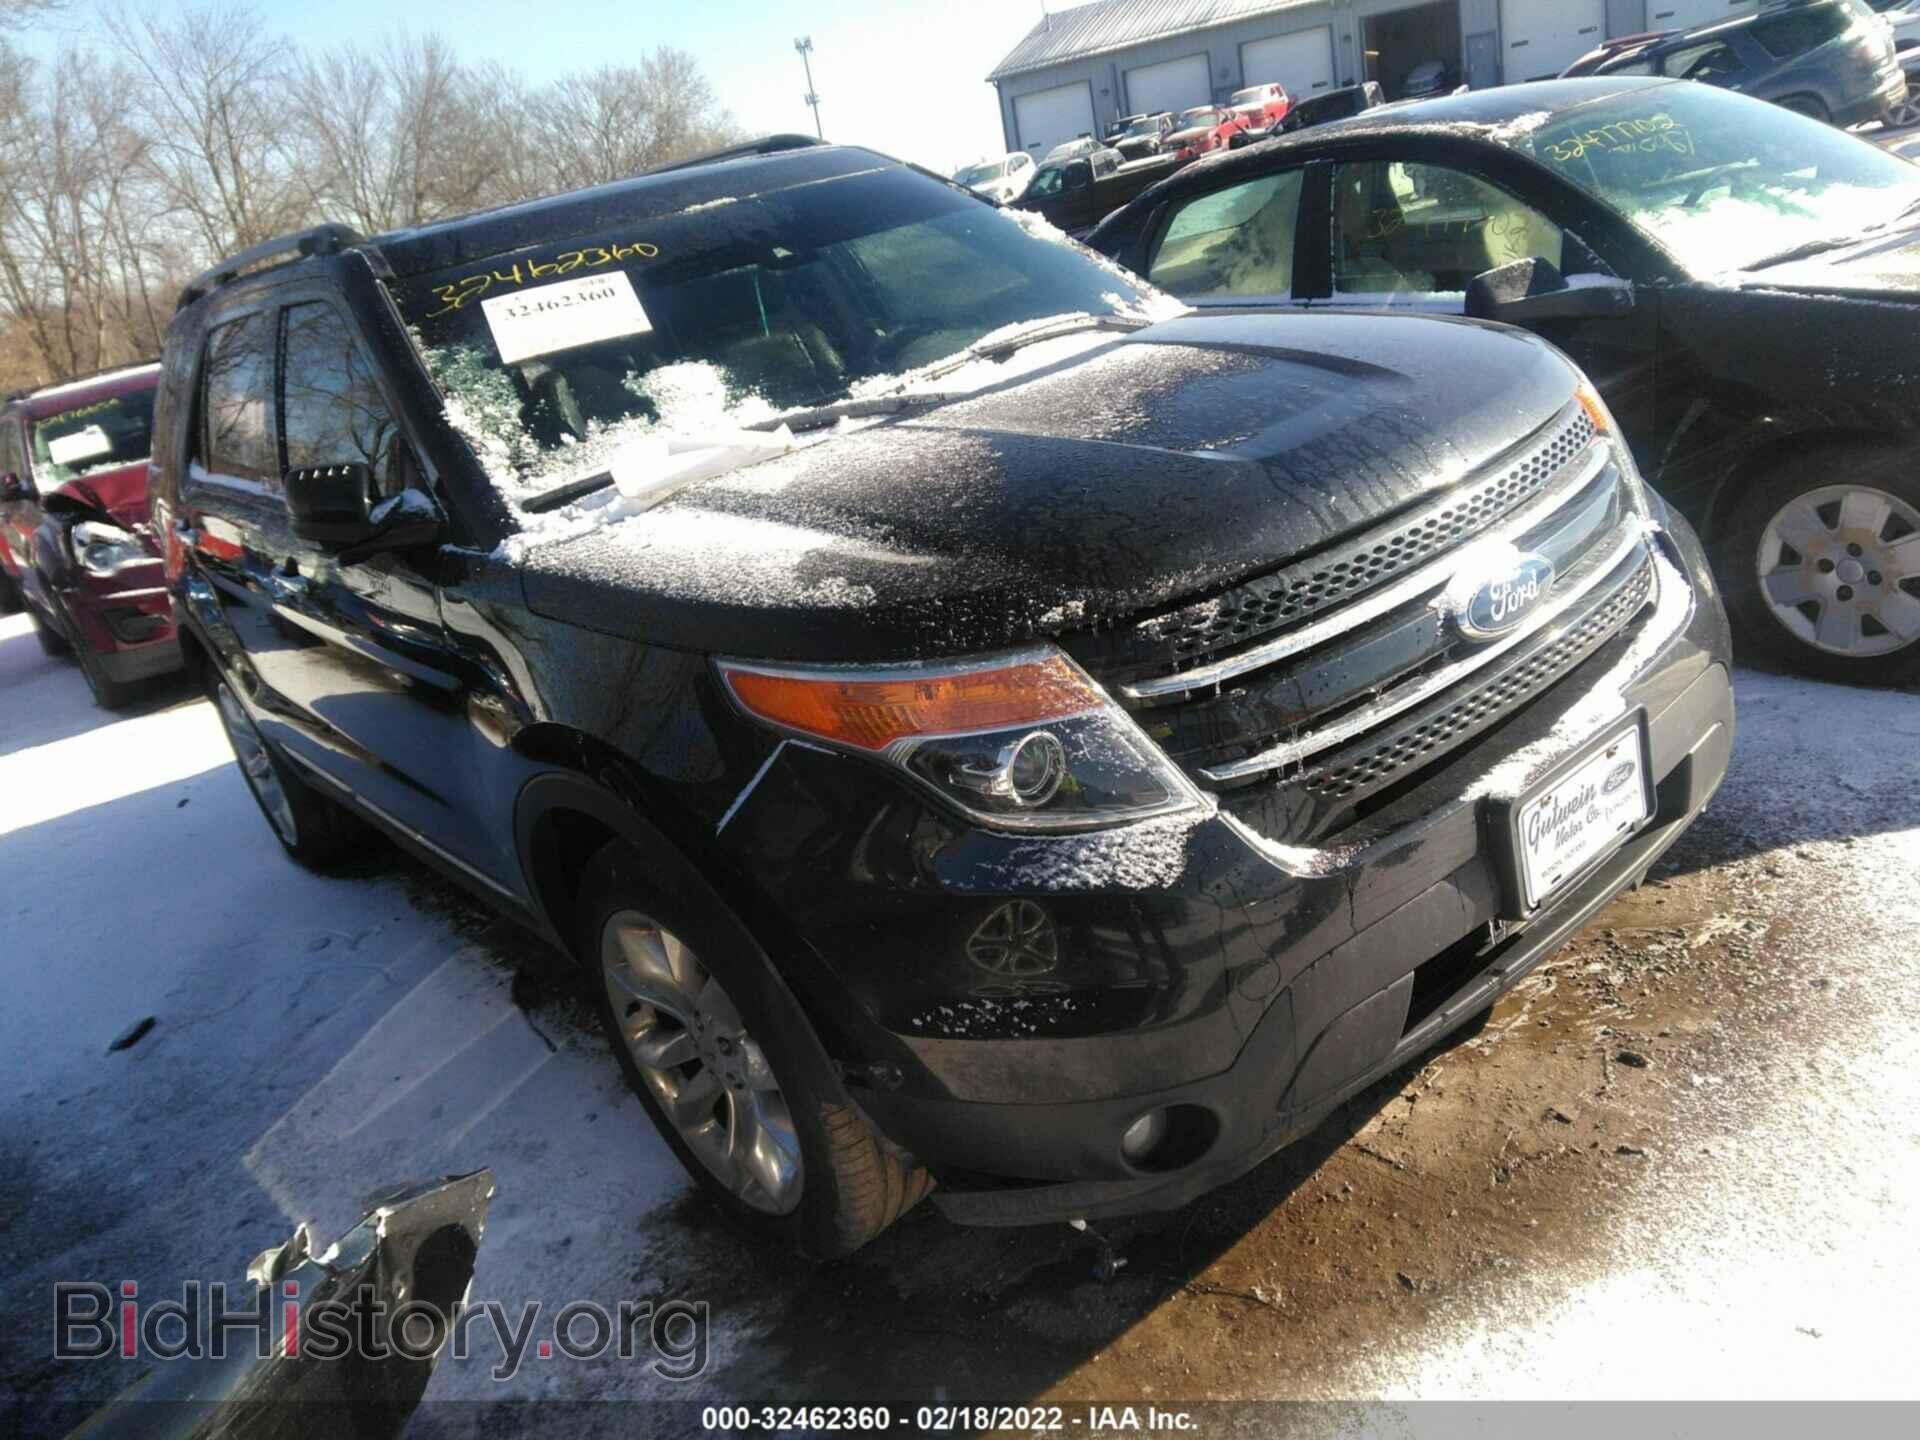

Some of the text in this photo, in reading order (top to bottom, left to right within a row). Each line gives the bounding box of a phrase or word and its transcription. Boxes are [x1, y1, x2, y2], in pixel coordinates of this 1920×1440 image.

[425, 243, 658, 318] 32462360
[503, 286, 616, 320] 32462360
[1489, 567, 1538, 621] Ford
